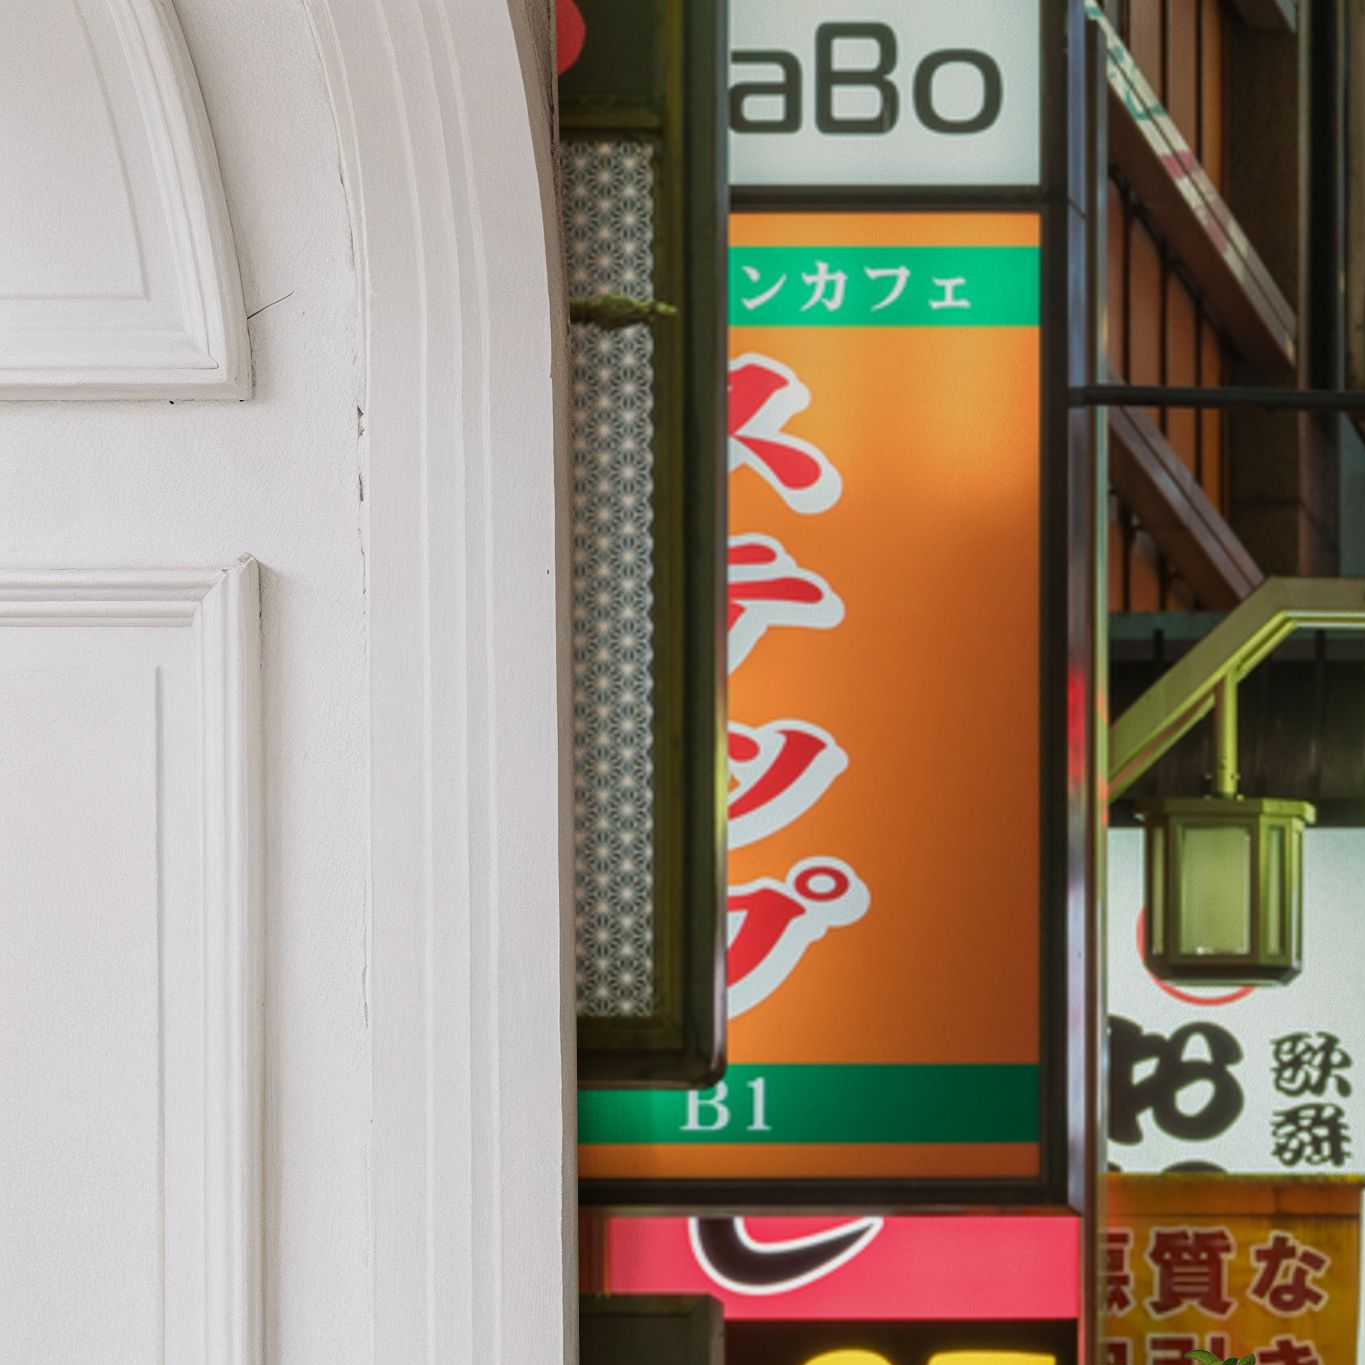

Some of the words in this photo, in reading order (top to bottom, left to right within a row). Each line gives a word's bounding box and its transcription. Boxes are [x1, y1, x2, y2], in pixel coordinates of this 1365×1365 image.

[728, 21, 1004, 134] aBo
[740, 260, 971, 312] ンカフェ
[680, 1076, 771, 1132] B1
